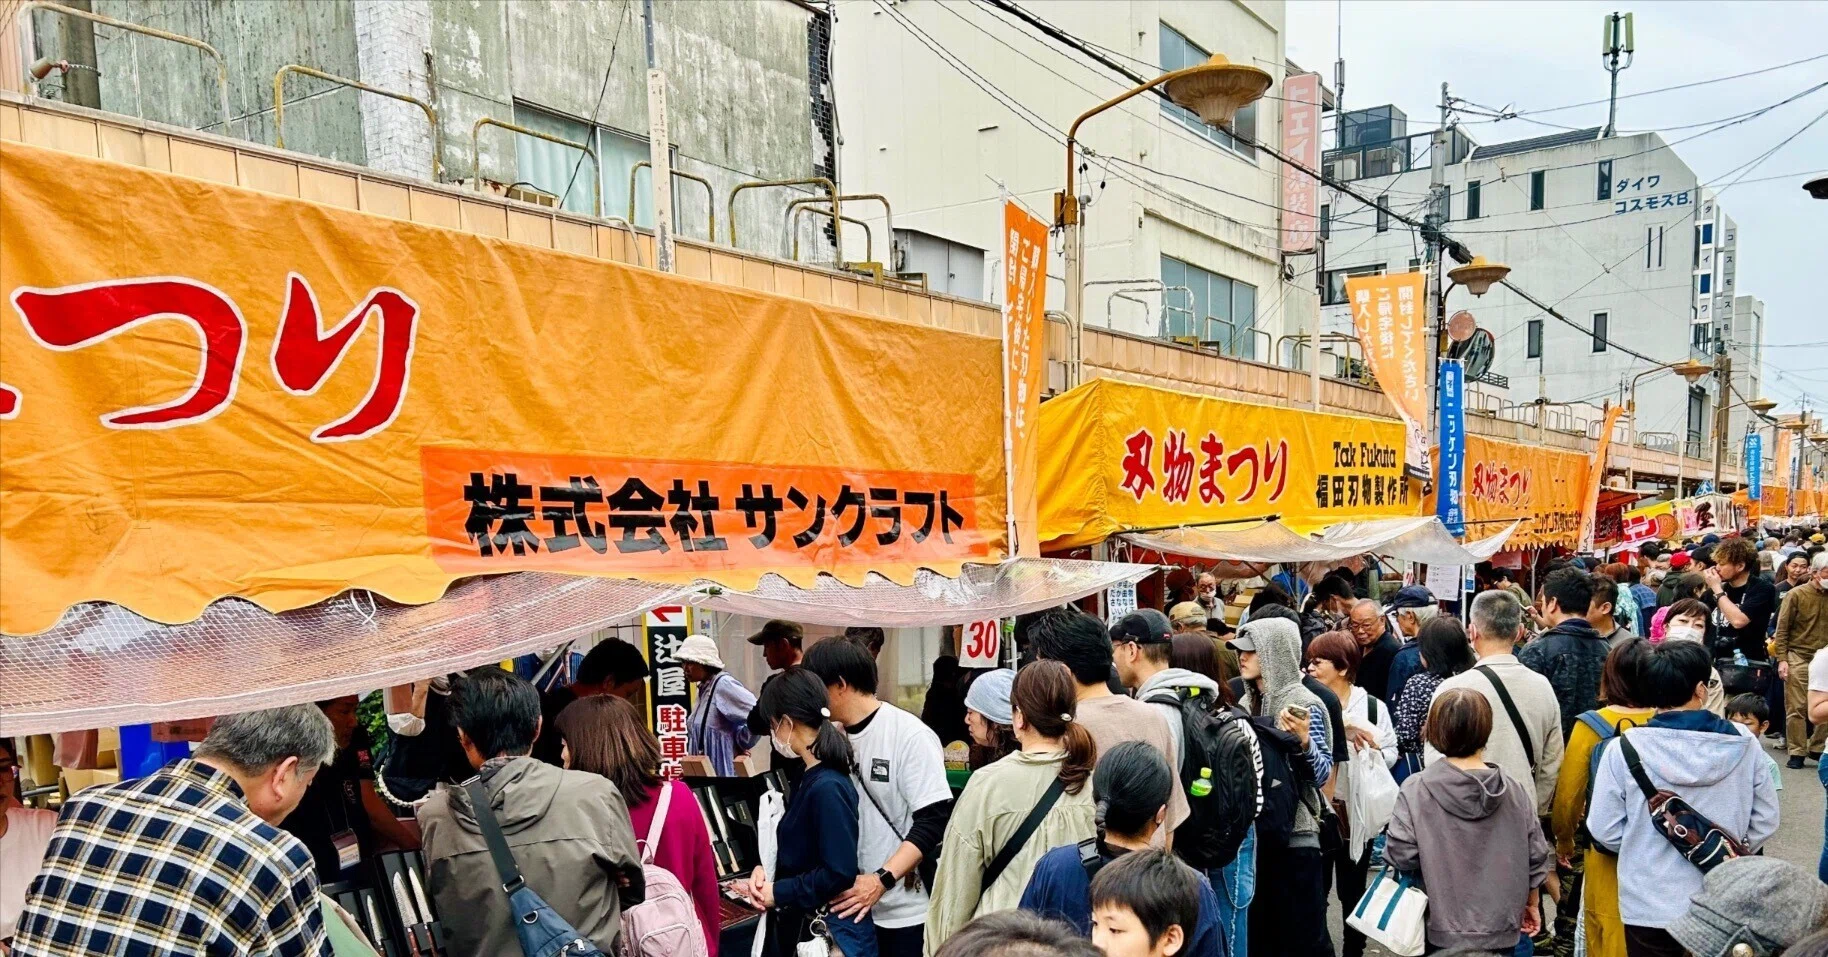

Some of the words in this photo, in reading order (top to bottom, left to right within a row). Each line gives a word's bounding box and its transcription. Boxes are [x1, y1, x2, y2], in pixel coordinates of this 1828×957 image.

[1616, 175, 1661, 193] ダイワ
[0, 271, 419, 443] つり
[1120, 428, 1289, 506] 刃物まつり
[1333, 441, 1357, 468] Tak
[1360, 442, 1397, 468] Fukuta
[1316, 474, 1409, 508] 福田刃物製作所
[1471, 461, 1532, 505] 刃物まつり
[463, 472, 728, 557] 株式会社
[735, 483, 964, 550] サンクラフト
[967, 620, 997, 658] 30
